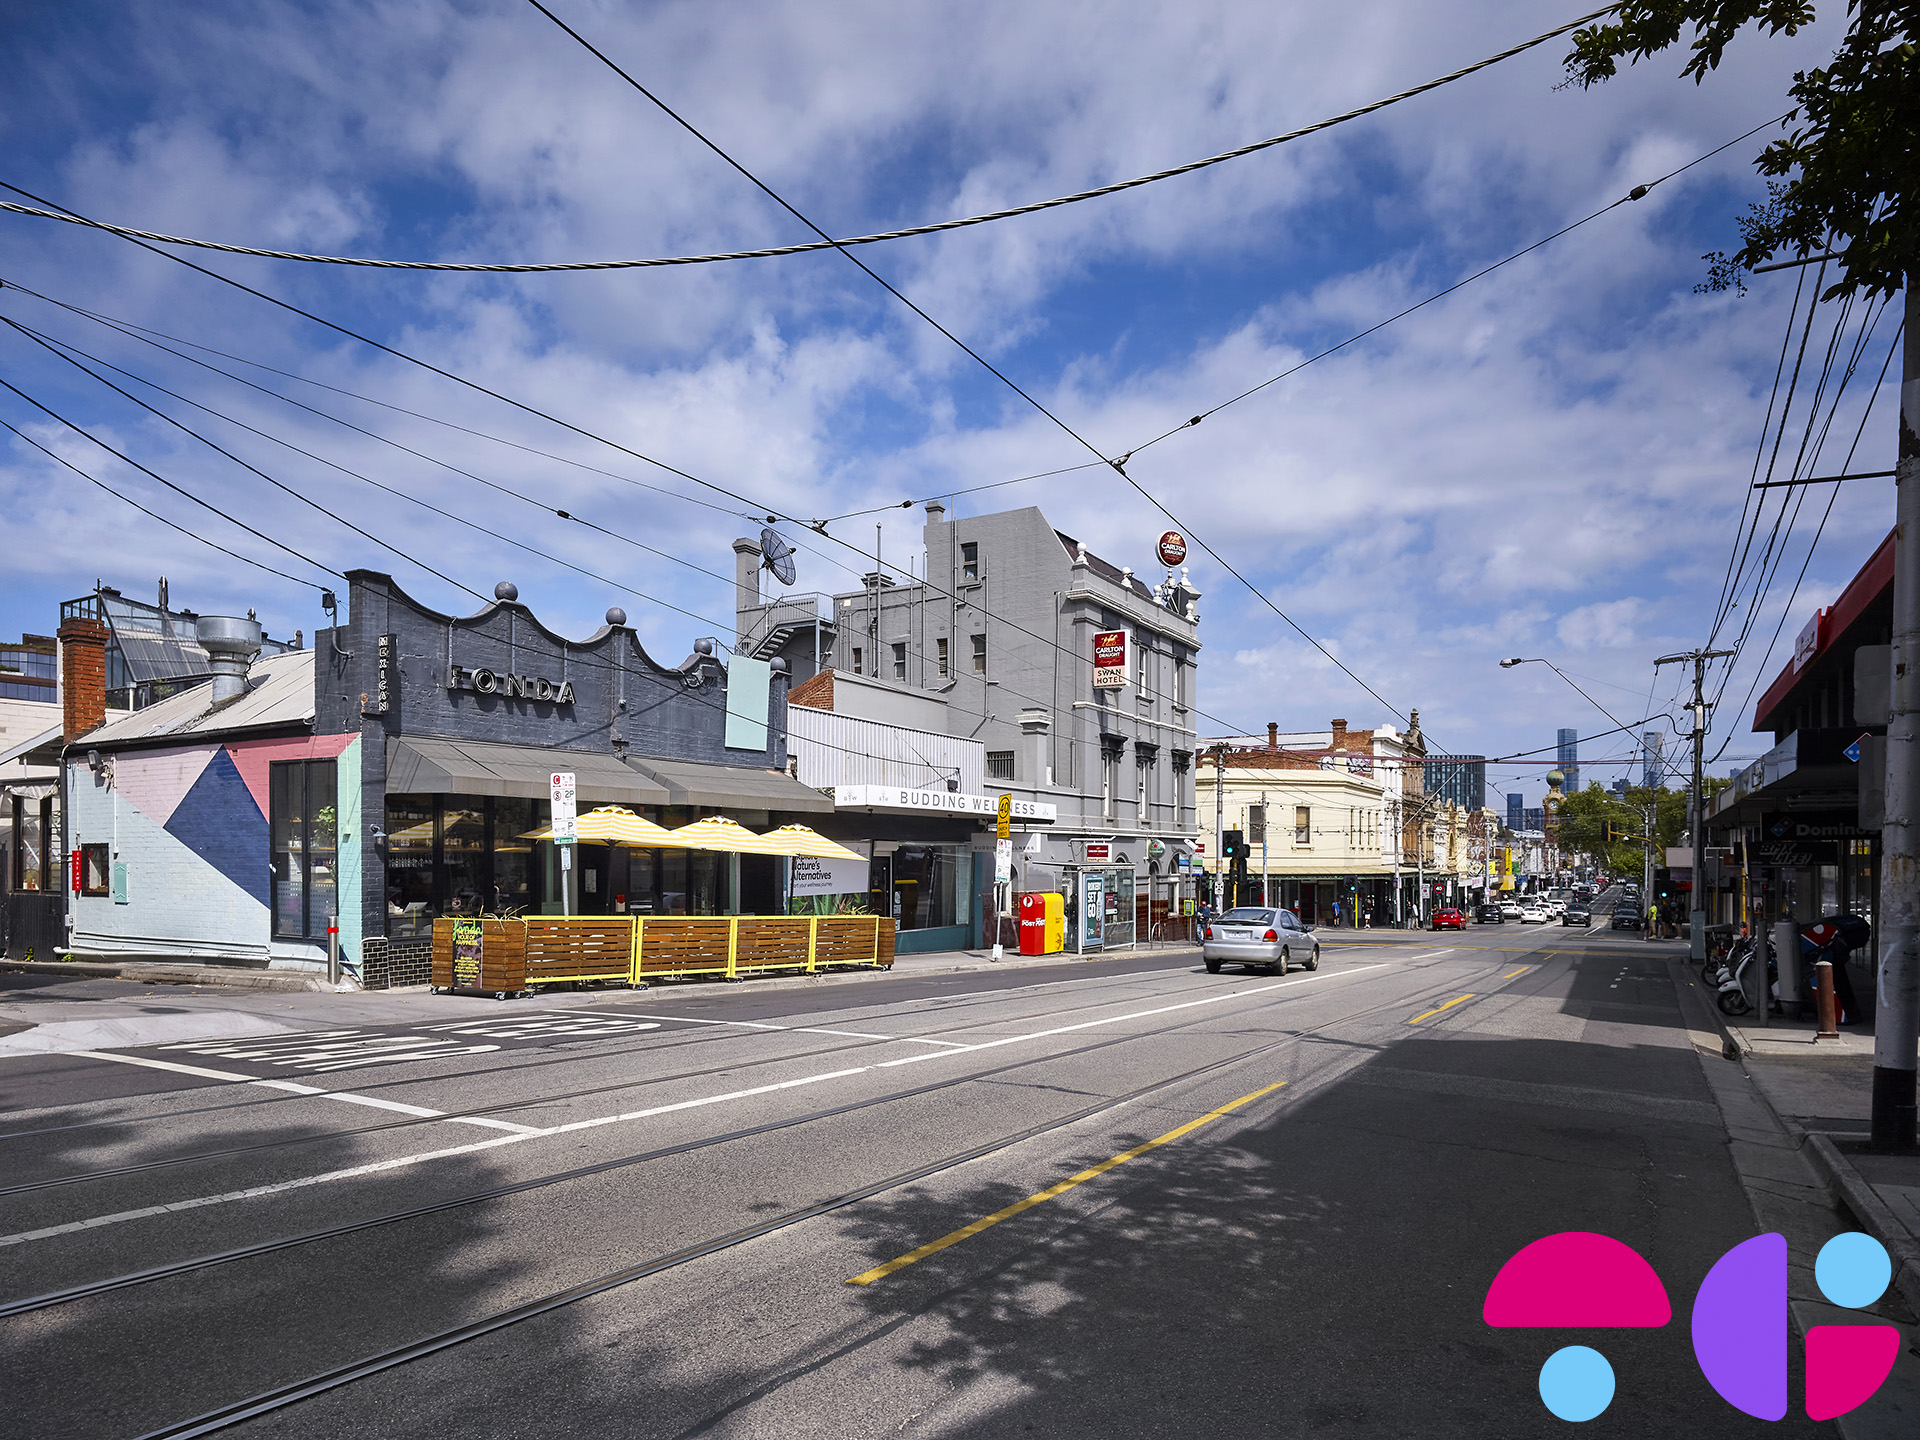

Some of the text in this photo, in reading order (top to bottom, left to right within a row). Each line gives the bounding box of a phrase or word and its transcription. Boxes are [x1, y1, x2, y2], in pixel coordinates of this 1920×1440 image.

[1096, 646, 1123, 654] CARLTON
[378, 635, 389, 712] MEXICAN
[446, 664, 577, 705] FONDA
[900, 791, 966, 809] BUDDING
[972, 799, 1036, 815] WELESS
[1000, 801, 1009, 813] 40
[1795, 822, 1878, 837] Domino
[410, 1014, 662, 1040] KEEP
[157, 1030, 502, 1072] CLEAR
